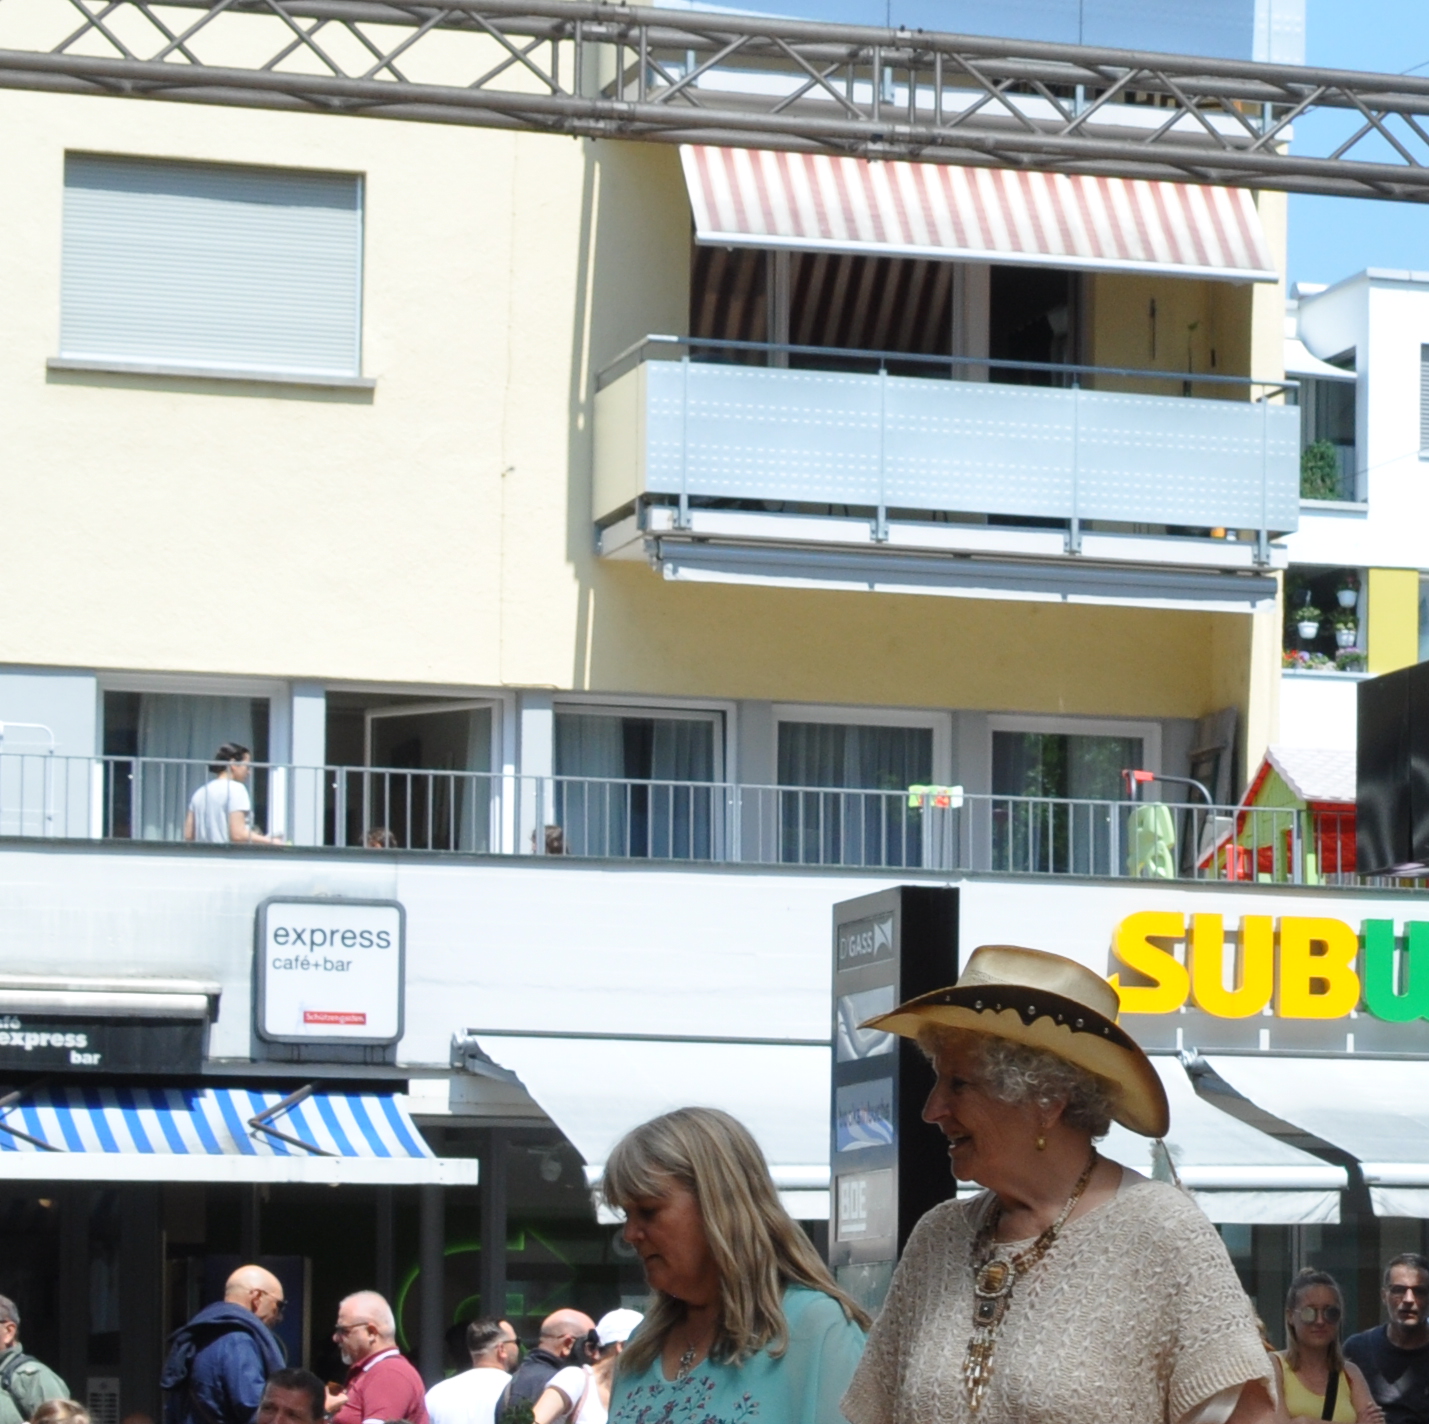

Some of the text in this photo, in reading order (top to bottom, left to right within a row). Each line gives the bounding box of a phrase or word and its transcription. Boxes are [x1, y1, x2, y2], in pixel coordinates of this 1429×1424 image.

[273, 926, 391, 953] express
[272, 955, 353, 972] café+bar
[0, 1031, 88, 1051] express
[70, 1050, 101, 1065] bar
